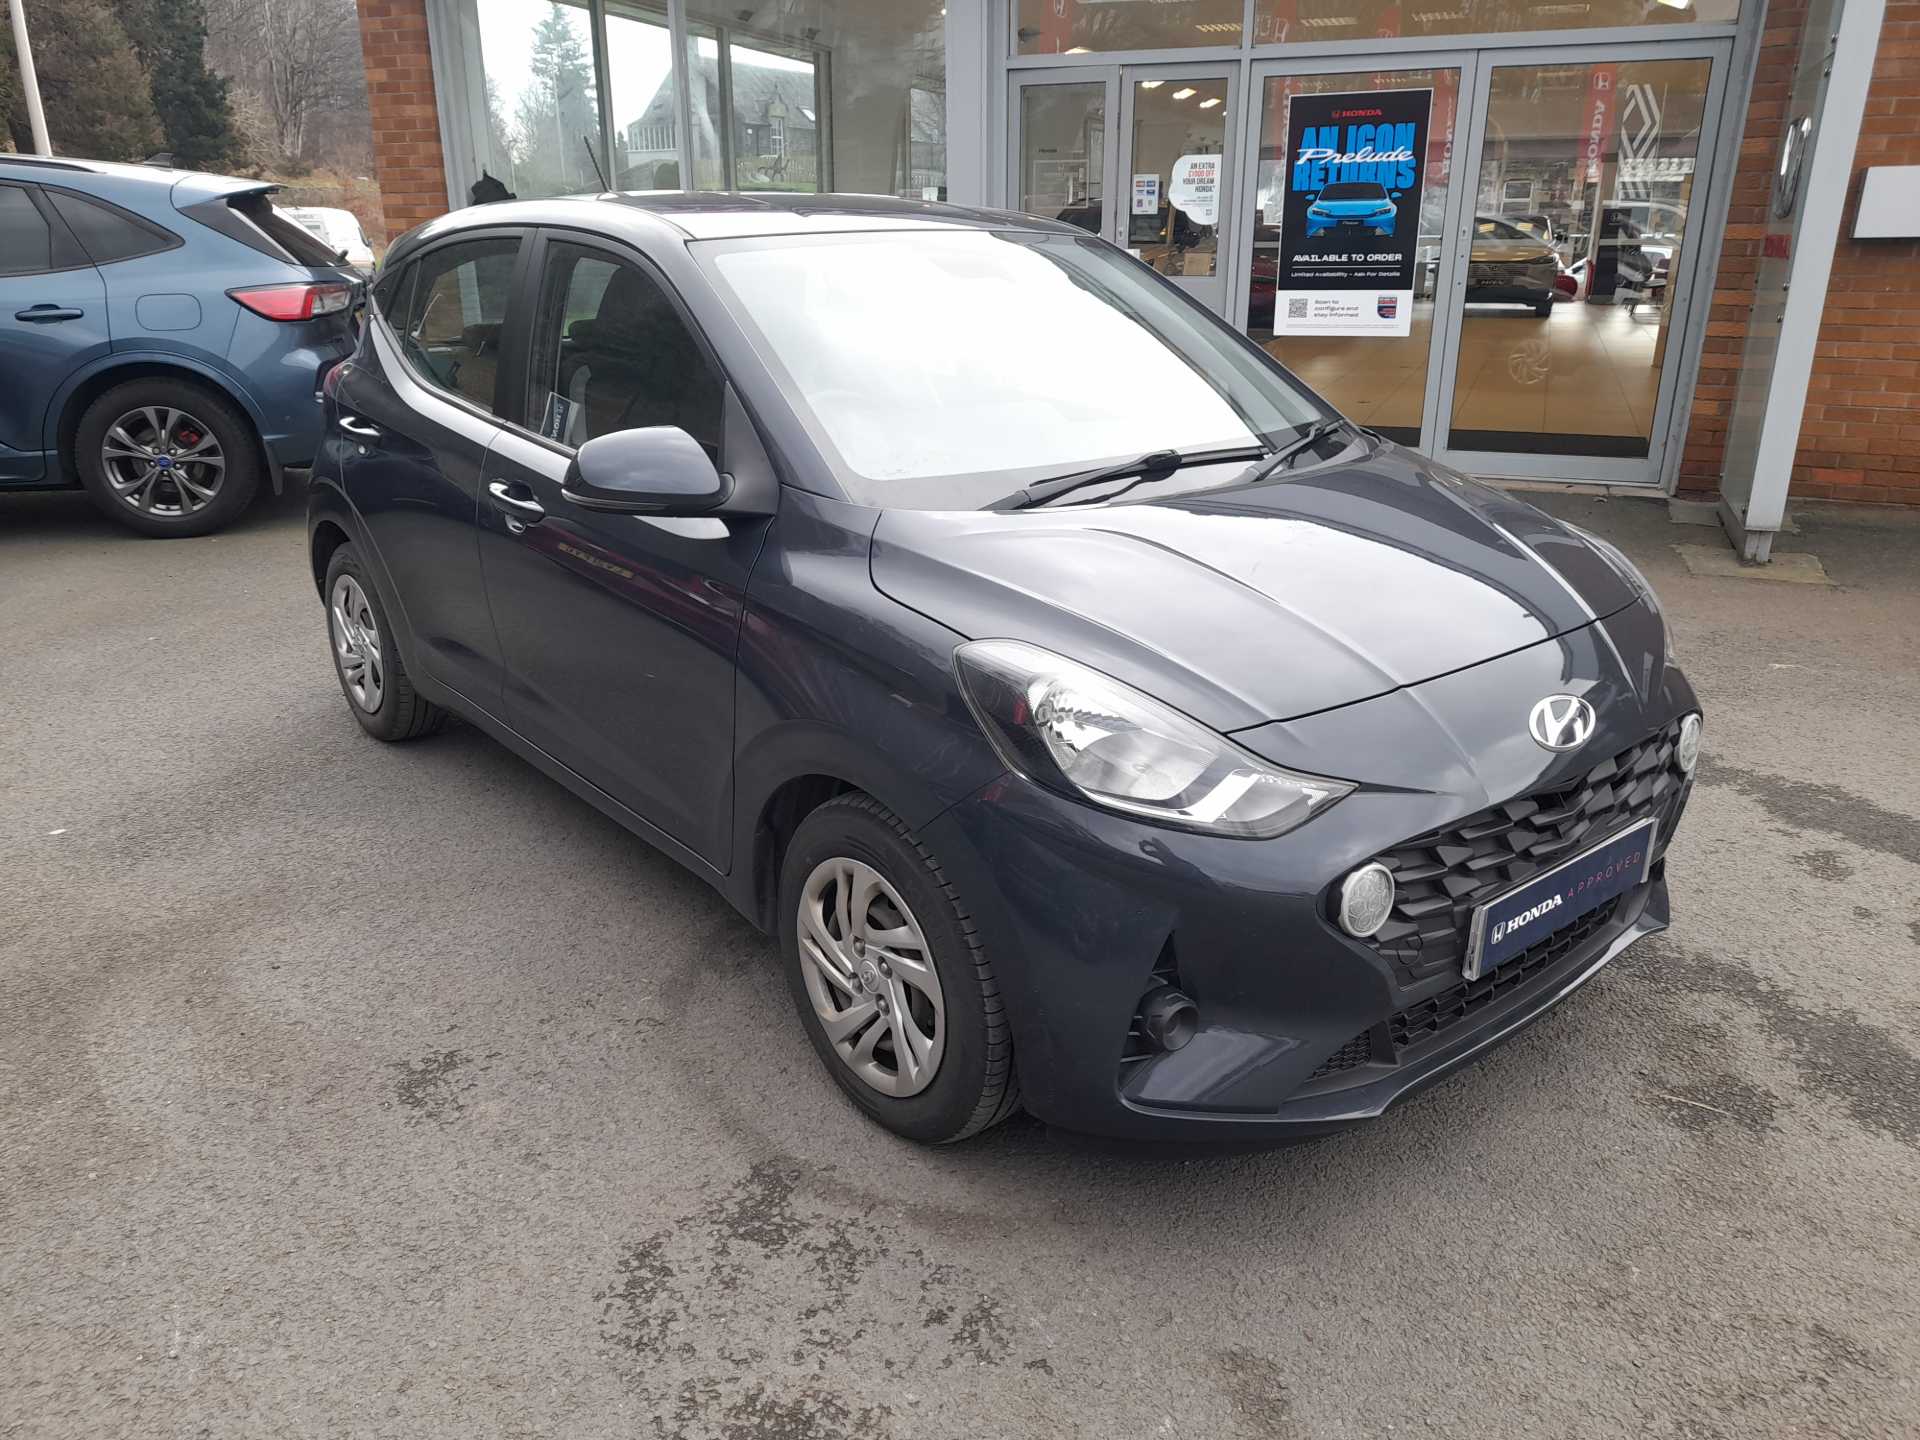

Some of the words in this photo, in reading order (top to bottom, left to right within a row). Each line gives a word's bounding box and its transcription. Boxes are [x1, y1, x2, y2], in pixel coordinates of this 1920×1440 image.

[1342, 109, 1382, 117] HONDA
[1301, 126, 1339, 156] AN
[1346, 122, 1416, 154] ICON
[1296, 145, 1414, 165] Prelude
[1292, 254, 1348, 262] AVAILABLE
[1366, 253, 1402, 261] ORDER
[1507, 894, 1563, 934] HONDA
[1568, 851, 1641, 898] APPROVED
